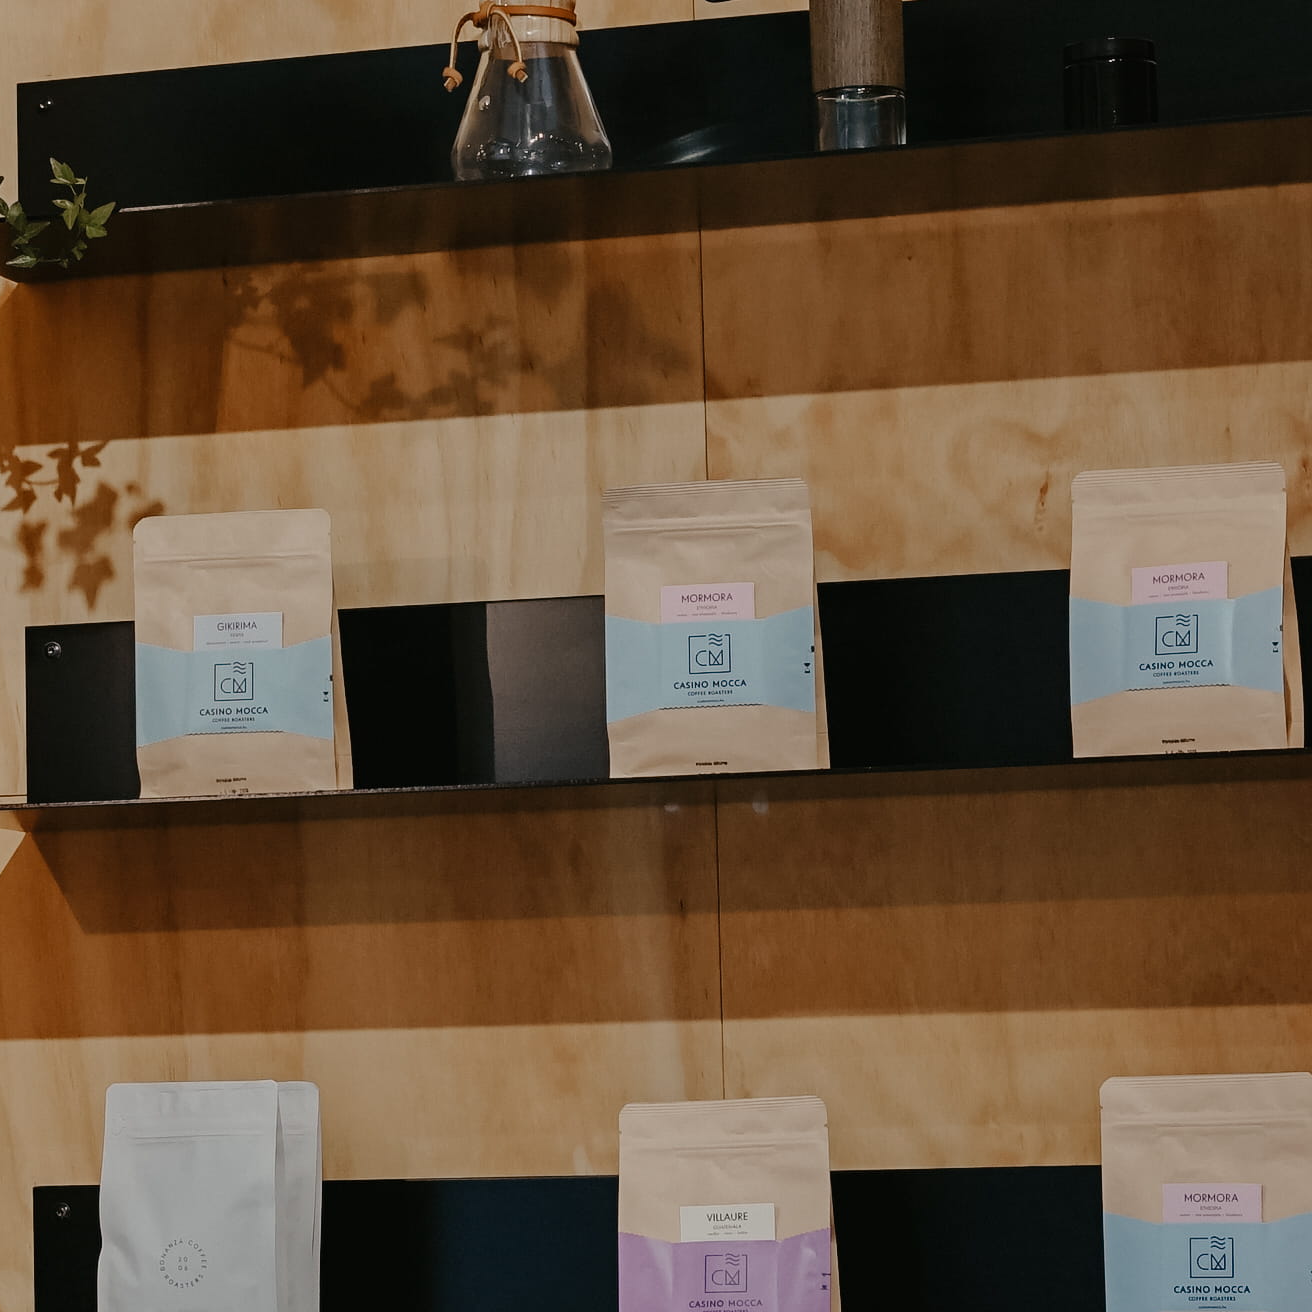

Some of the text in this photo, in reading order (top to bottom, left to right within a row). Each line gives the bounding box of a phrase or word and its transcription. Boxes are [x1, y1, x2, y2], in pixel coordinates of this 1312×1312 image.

[1152, 572, 1206, 585] MORMORA
[681, 592, 734, 604] MORMORA
[217, 621, 258, 632] GIKIRIMA
[1139, 659, 1214, 671] CASINO MOCCA
[673, 679, 748, 690] CASINO MOCCA
[199, 706, 269, 717] CASINO MOCCA
[1184, 1193, 1239, 1203] MORMORA
[706, 1211, 749, 1222] VILLAURE
[1173, 1285, 1251, 1294] CASINO MOCCA
[689, 1298, 763, 1308] CASINO MOCCA
